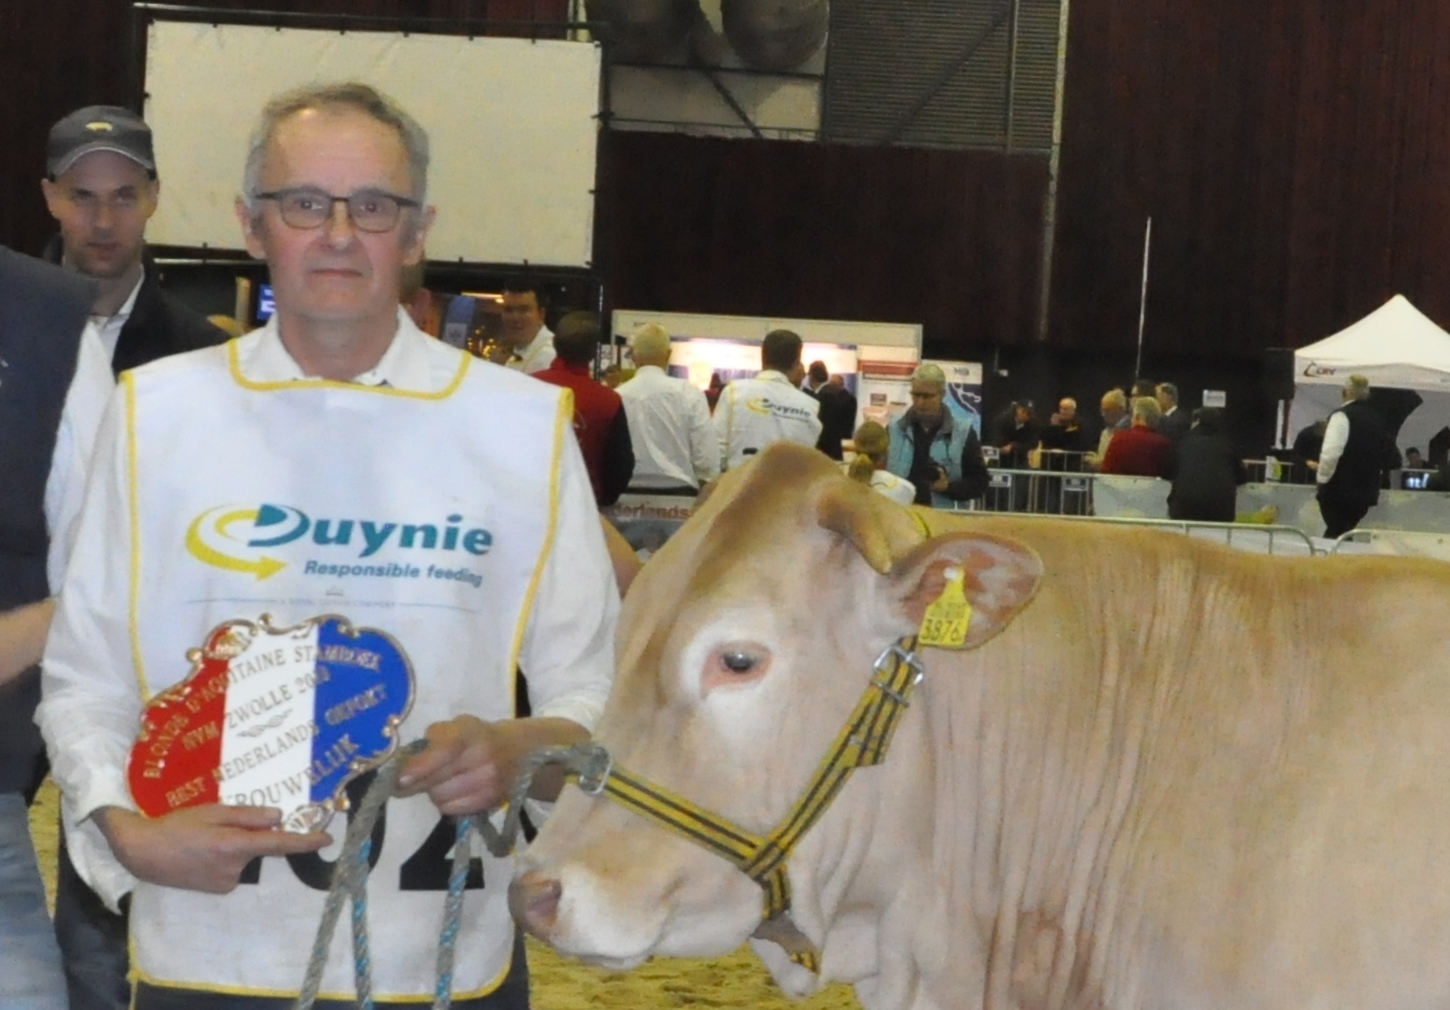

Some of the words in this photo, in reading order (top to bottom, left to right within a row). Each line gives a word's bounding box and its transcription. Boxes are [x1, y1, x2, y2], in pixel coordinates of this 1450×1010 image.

[247, 503, 494, 558] Duynie
[303, 559, 421, 580] Responsible
[426, 565, 484, 589] feeding
[224, 683, 294, 730] ZWOLLE
[164, 776, 208, 808] BEST
[211, 719, 321, 784] NEDERLANDS
[224, 732, 361, 809] ROUWELIJK
